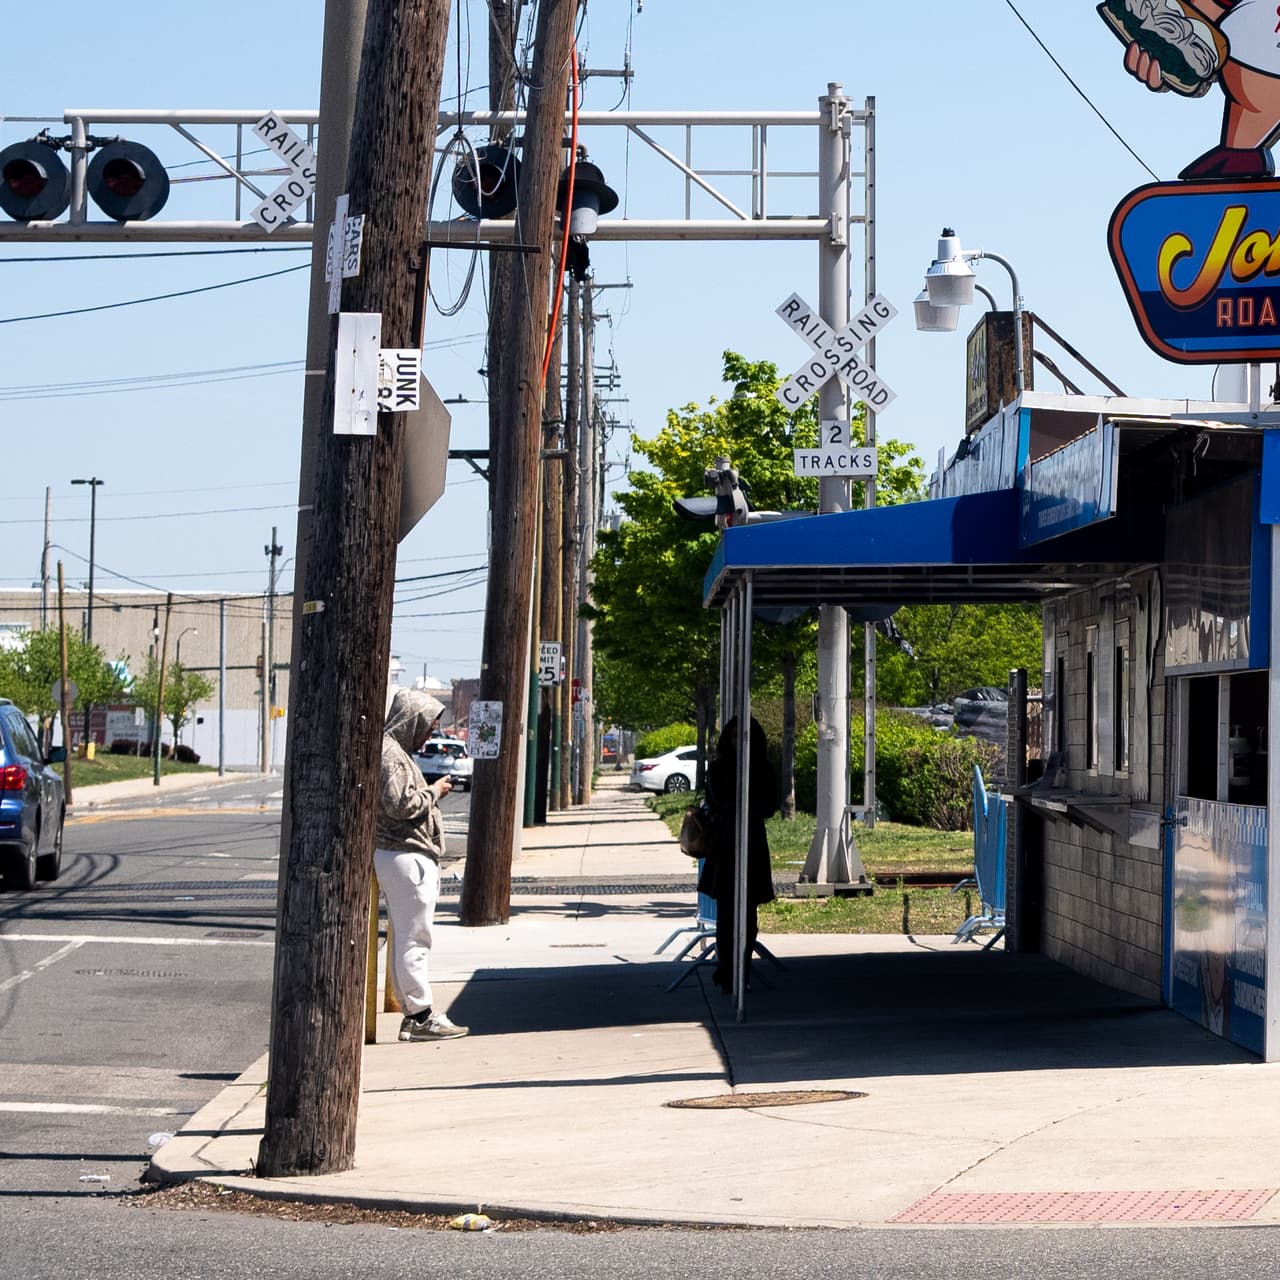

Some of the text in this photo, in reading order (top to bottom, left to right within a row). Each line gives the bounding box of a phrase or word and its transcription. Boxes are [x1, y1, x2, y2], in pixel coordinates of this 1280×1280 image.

[260, 167, 316, 224] CROS
[396, 353, 417, 407] JUNK
[783, 301, 890, 405] CROSSING
[829, 425, 842, 444] 2
[800, 454, 873, 470] TRACKS
